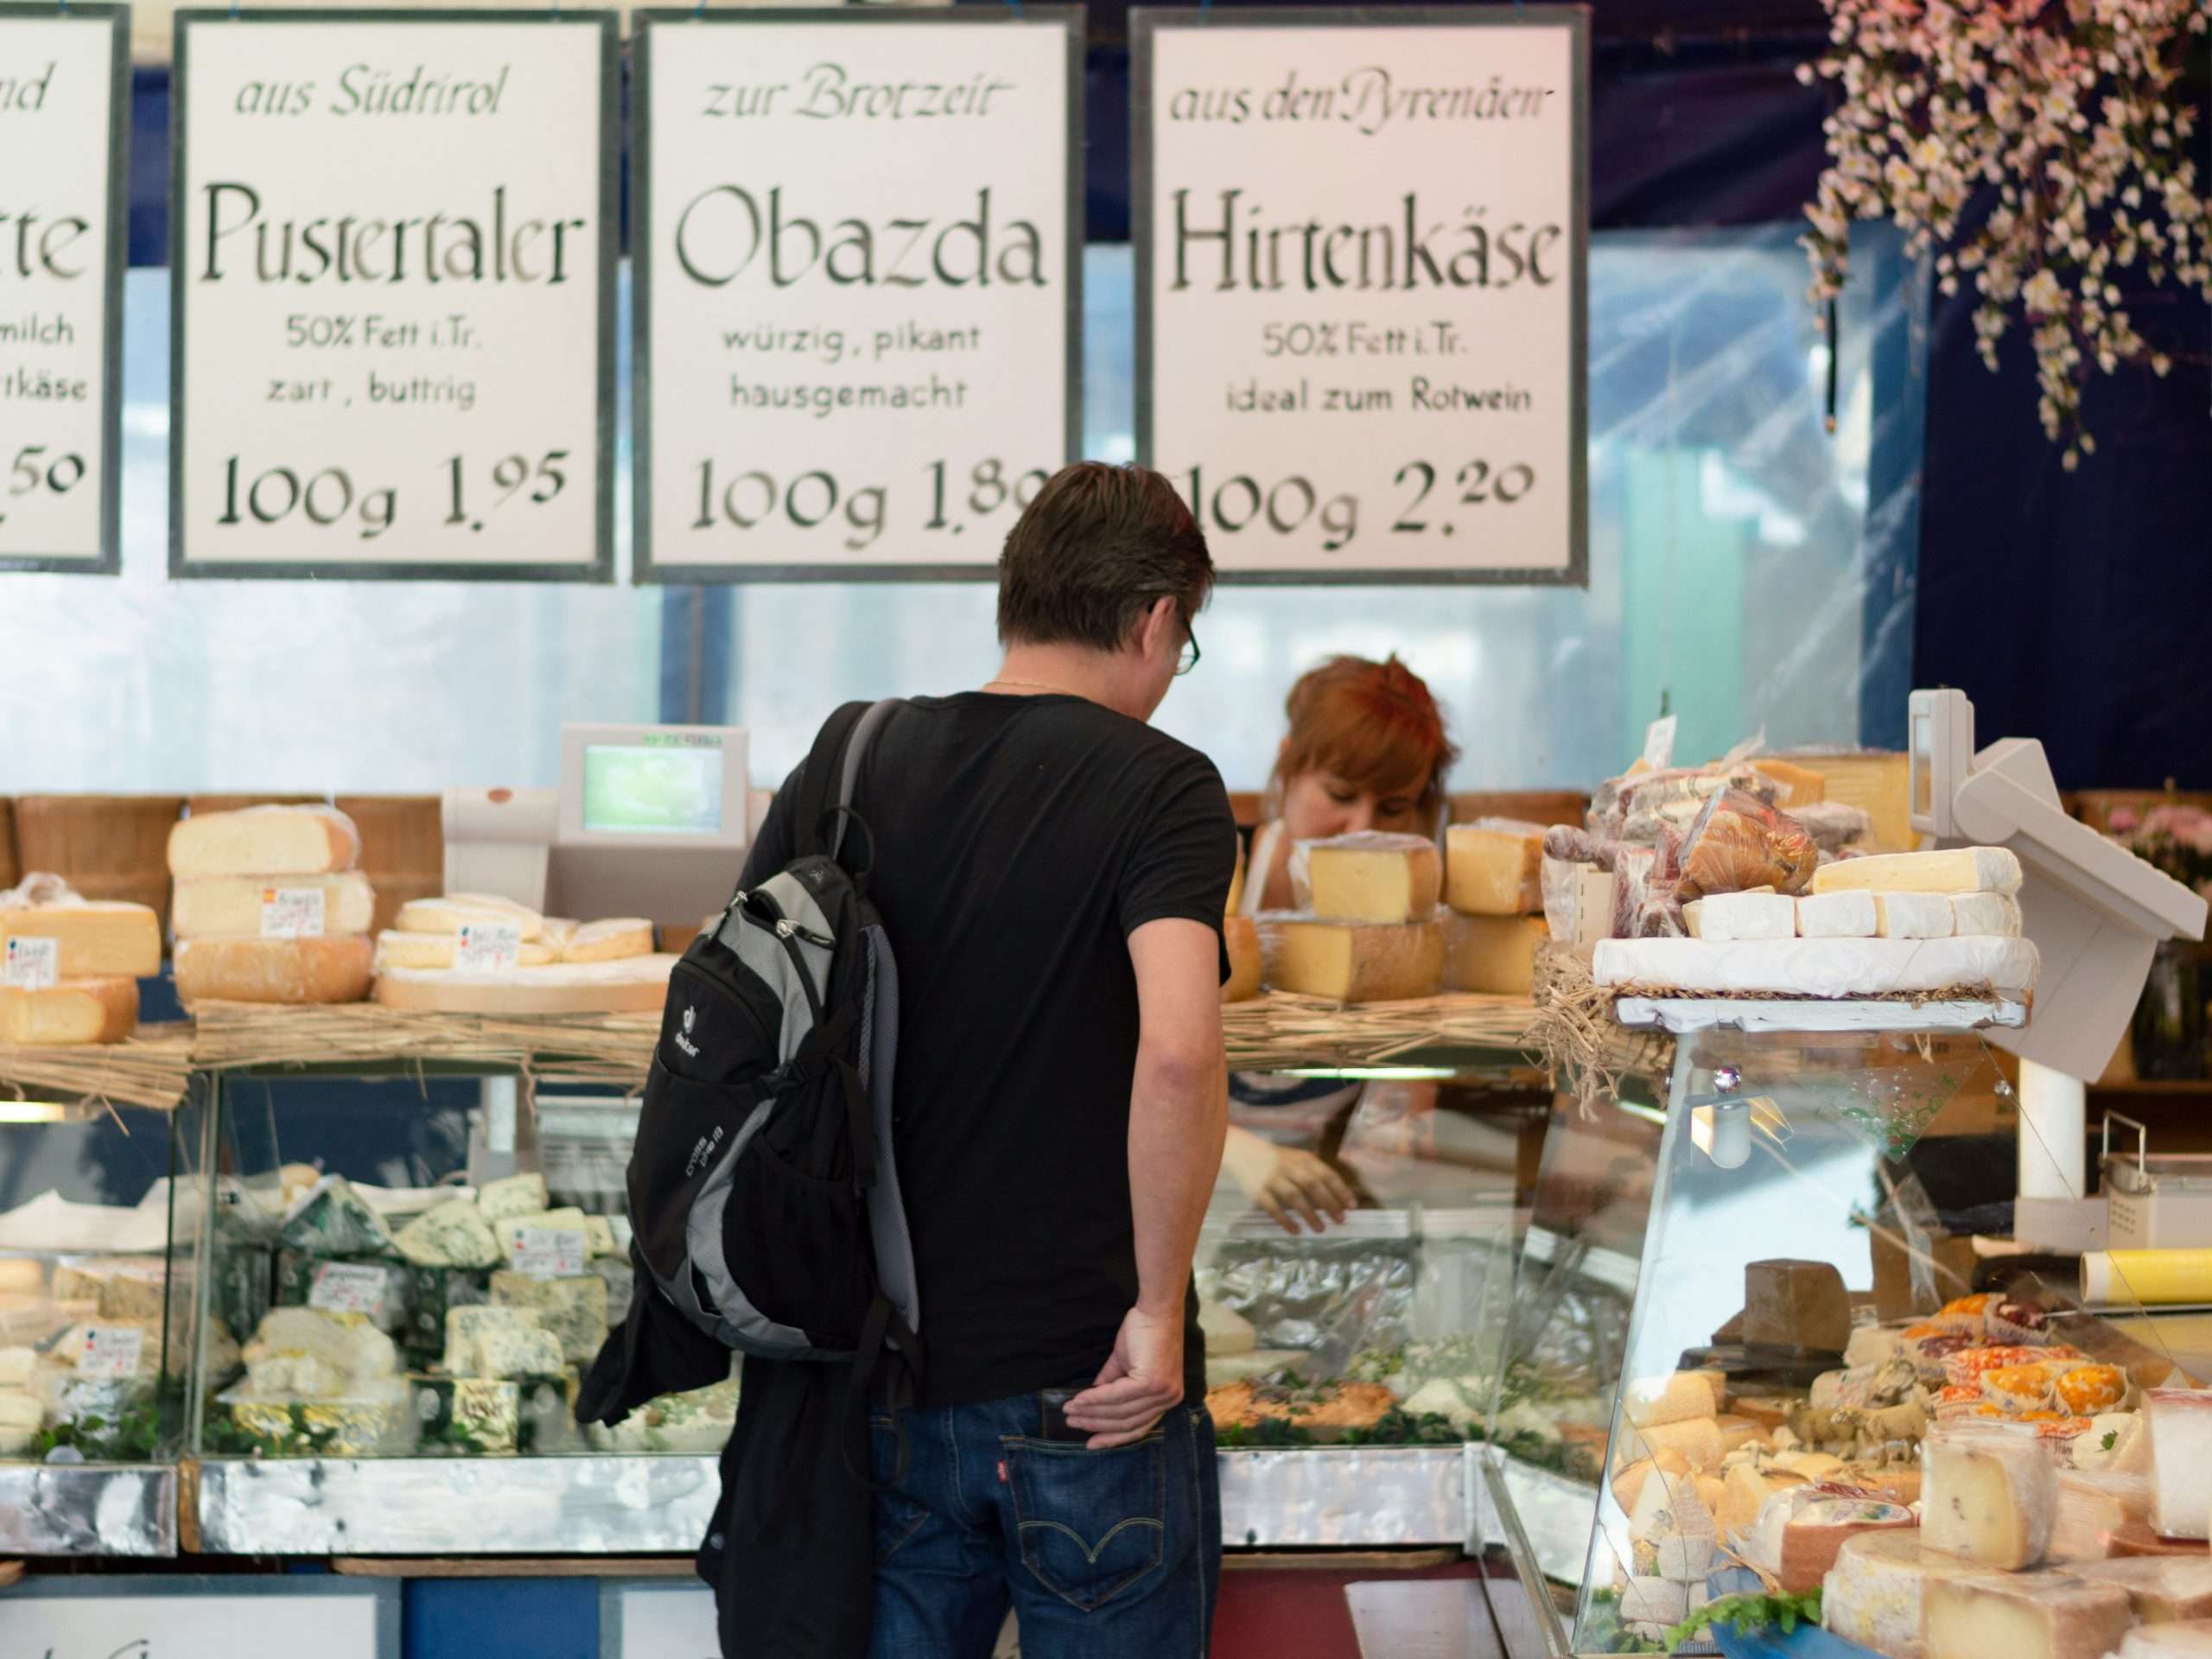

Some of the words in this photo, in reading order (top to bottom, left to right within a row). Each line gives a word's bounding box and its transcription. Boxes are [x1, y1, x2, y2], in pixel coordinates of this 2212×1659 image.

[234, 79, 315, 116] aus
[329, 62, 512, 117] Südtirol
[702, 83, 788, 118] zur
[794, 62, 1016, 120] Brotzeit
[1169, 87, 1252, 125] aus
[1261, 70, 1337, 122] den
[1339, 65, 1554, 137] Pyrenäen
[0, 211, 91, 281] te
[200, 181, 588, 286] Pustertaler
[675, 183, 1050, 289] Obazda
[1169, 188, 1562, 294] Hirtenkäse
[286, 314, 356, 349] 50%
[363, 314, 420, 349] Fett
[873, 320, 982, 362] pikant
[367, 370, 476, 412] buttrig
[730, 373, 969, 420] hausgemacht
[1225, 377, 1309, 414] ideal
[1321, 388, 1394, 413] zum
[1411, 375, 1532, 413] Rotwein
[216, 454, 397, 540] 100g
[690, 458, 887, 551] 100g
[1186, 463, 1359, 551] 100g
